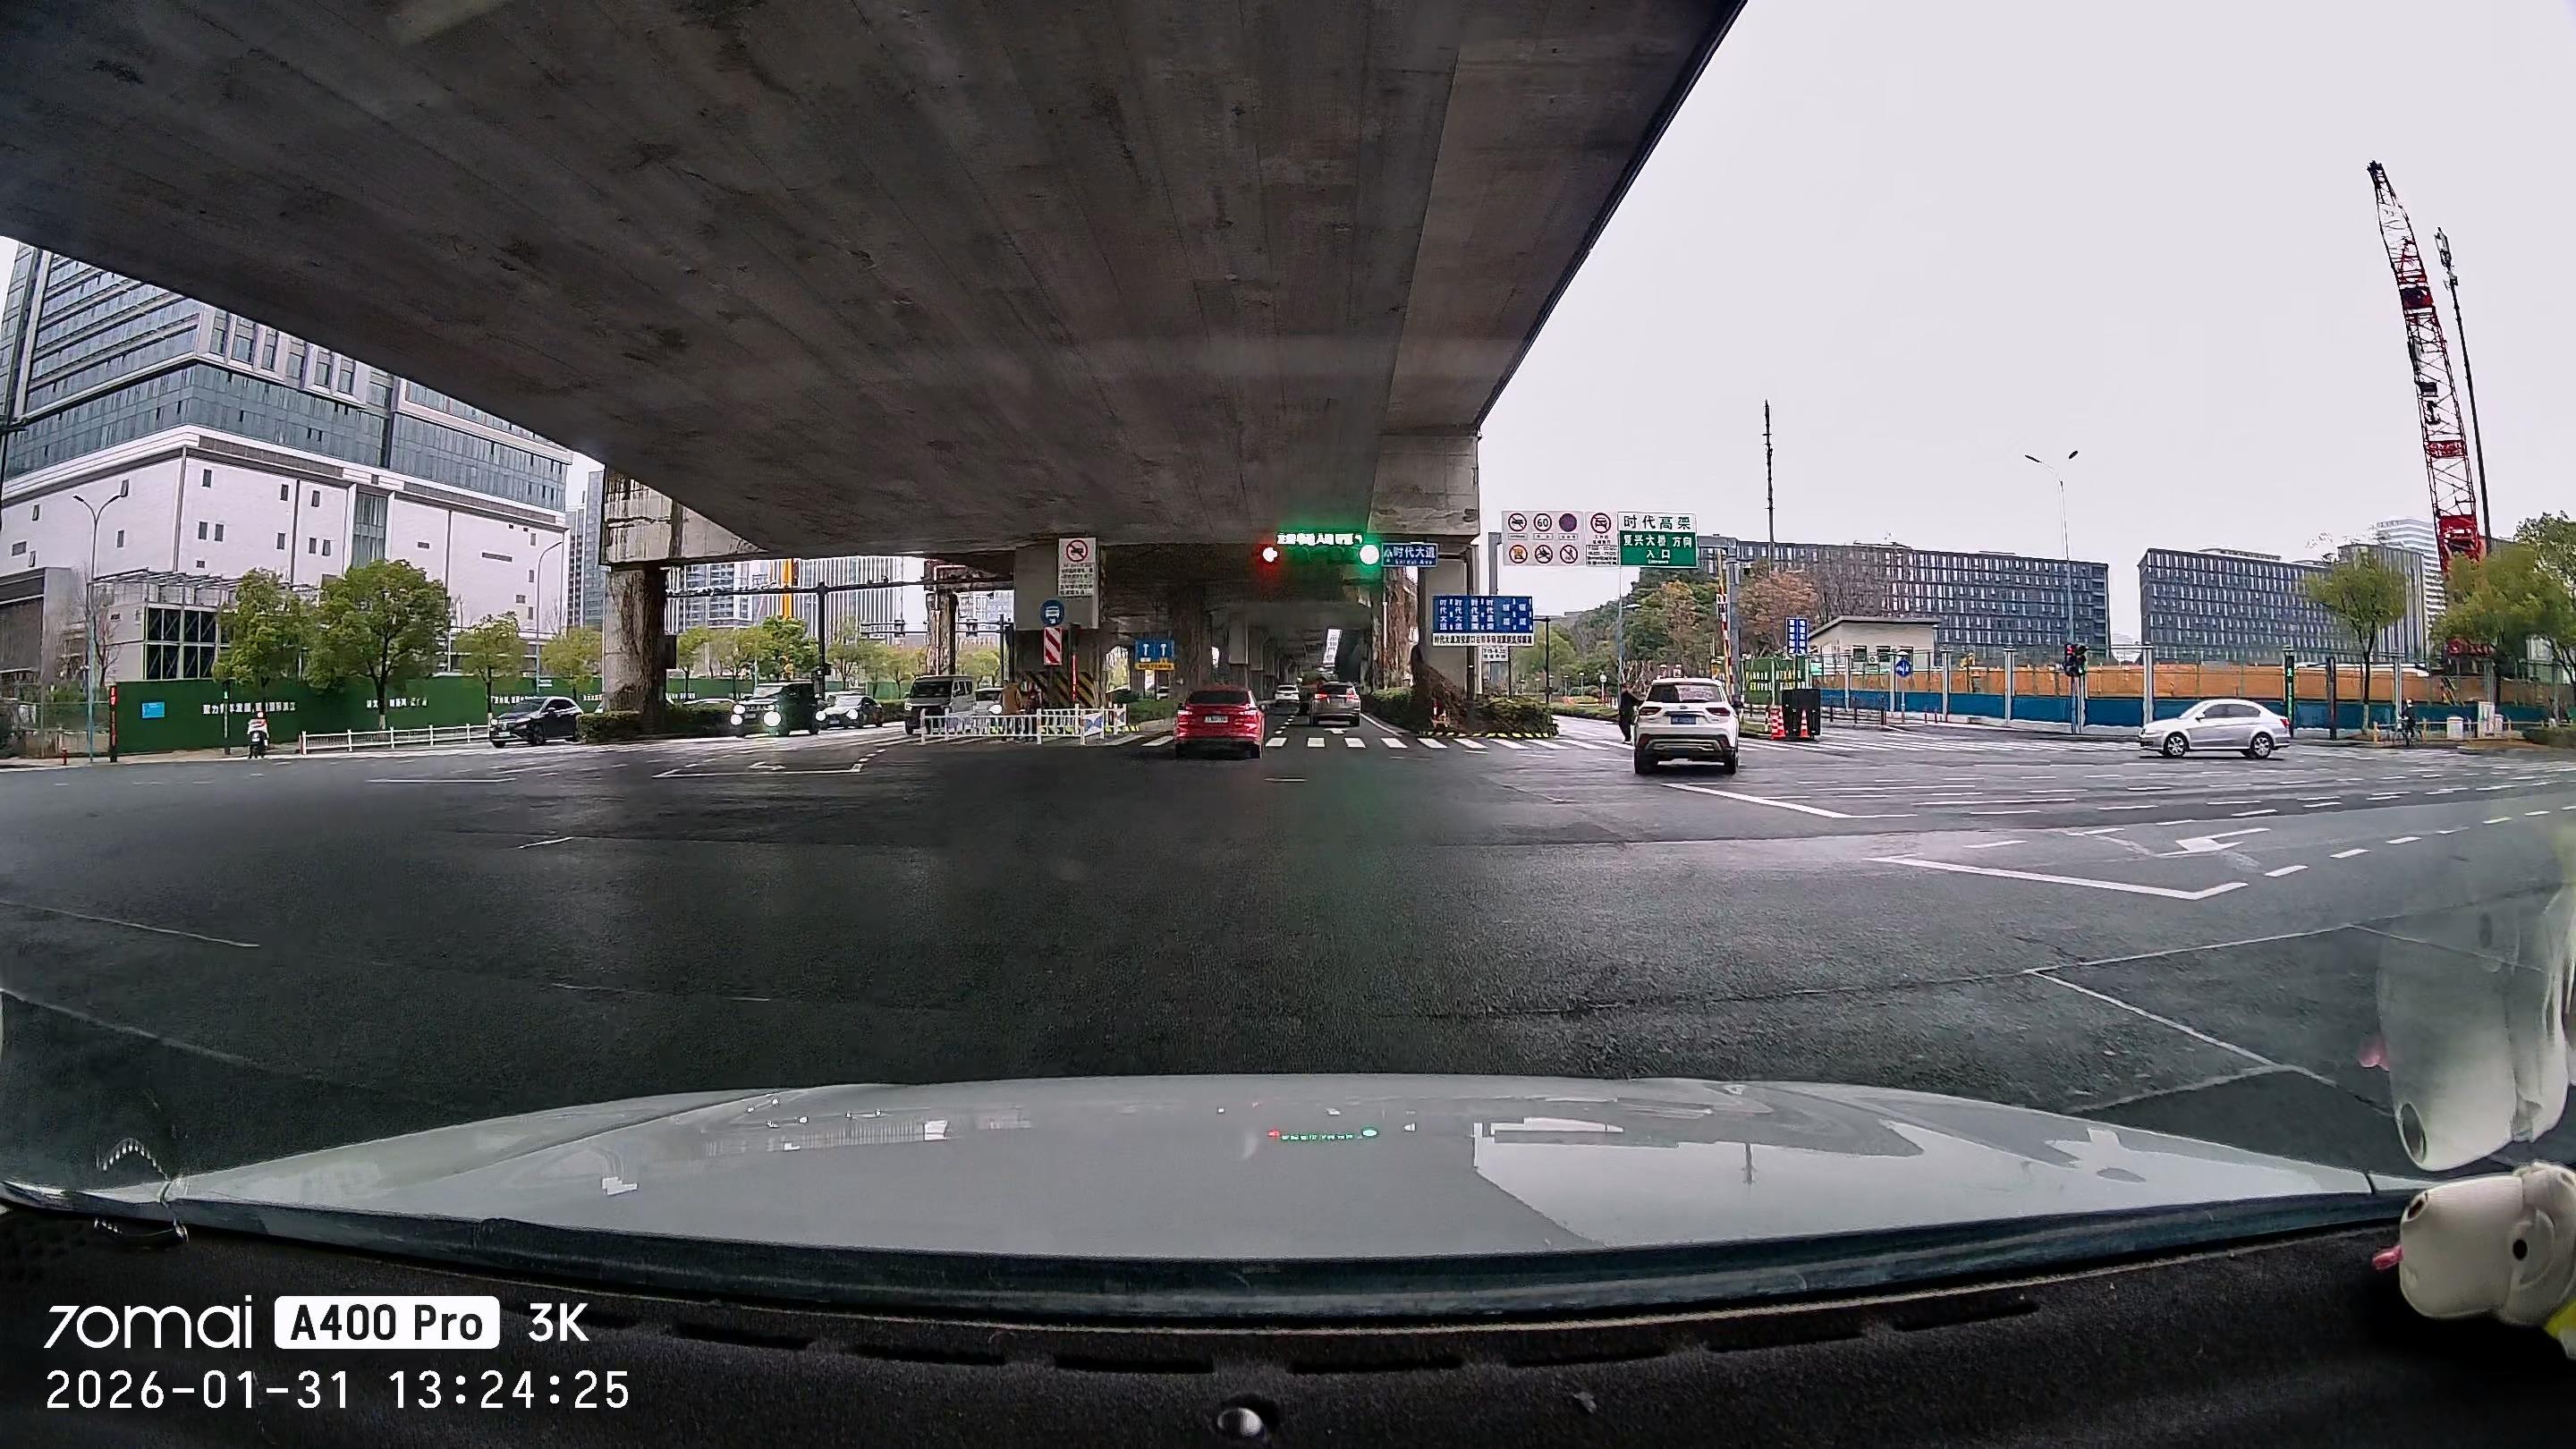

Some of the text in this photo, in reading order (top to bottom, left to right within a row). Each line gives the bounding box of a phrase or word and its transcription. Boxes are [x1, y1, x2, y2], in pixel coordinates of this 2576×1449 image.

[1538, 518, 1549, 528] 60
[1623, 514, 1691, 530] 时代高架
[1673, 536, 1692, 547] 方向
[1393, 546, 1436, 558] 时代大道
[1646, 549, 1671, 559] 入口
